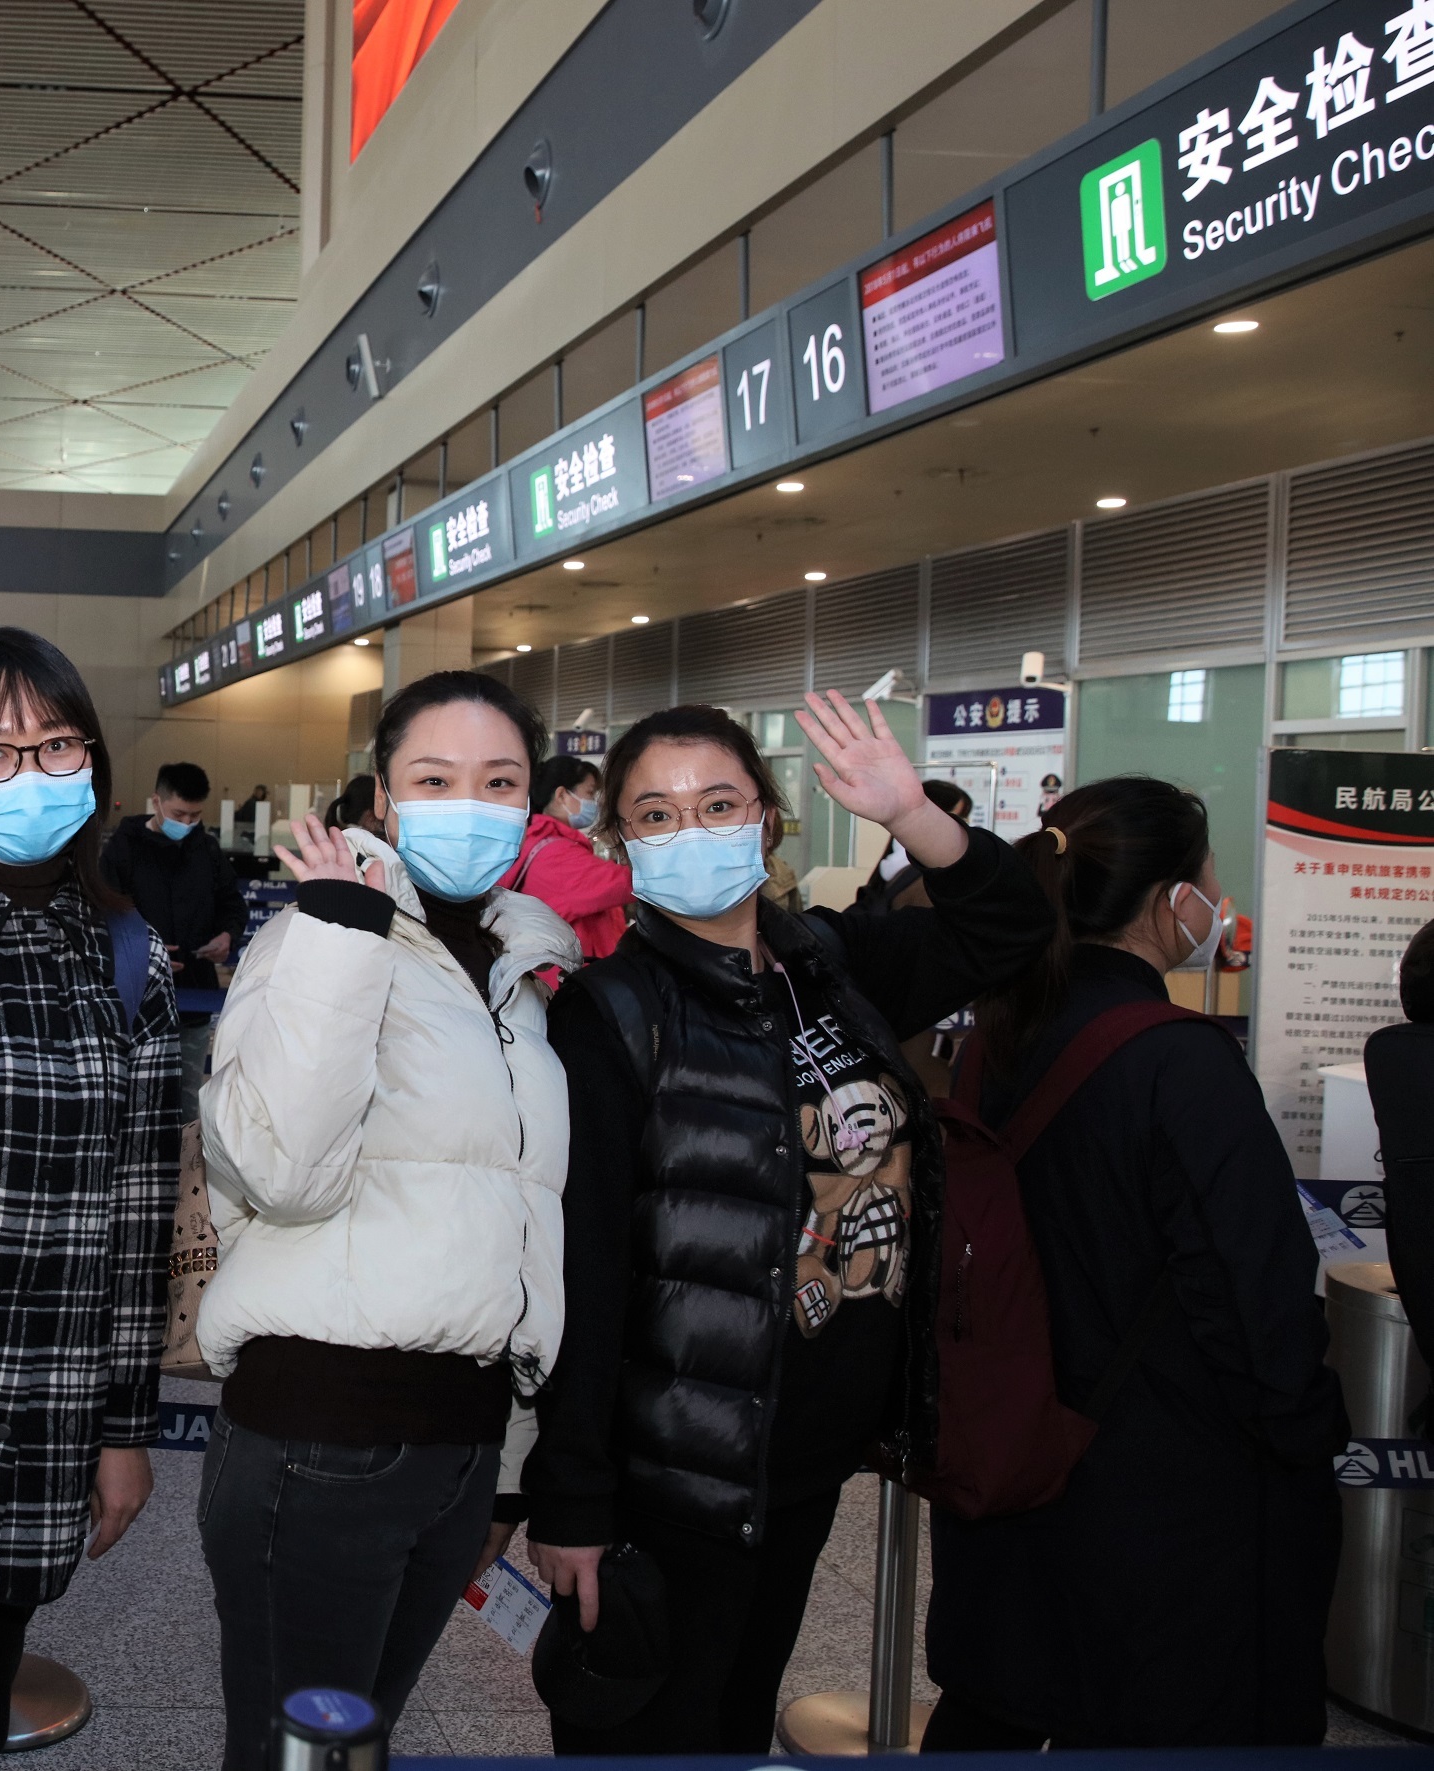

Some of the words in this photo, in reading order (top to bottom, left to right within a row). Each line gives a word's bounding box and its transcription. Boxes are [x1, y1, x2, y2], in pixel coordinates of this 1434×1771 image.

[1177, 0, 1434, 201] 安全检查
[1182, 172, 1322, 260] Security
[802, 323, 846, 402] 16
[736, 358, 772, 432] 17
[554, 434, 617, 502] 安全检查
[446, 500, 490, 552] 安全检查
[557, 502, 591, 530] Security
[590, 486, 619, 516] Check
[352, 573, 365, 608] 19
[369, 563, 383, 600] 18
[953, 702, 984, 727] 公安
[1006, 697, 1041, 724] 提示
[263, 881, 288, 890] HLJA
[1294, 861, 1432, 879] 关于重申民航旅客携带
[1350, 886, 1434, 901] 乘机规定的公
[162, 1414, 211, 1442] JA
